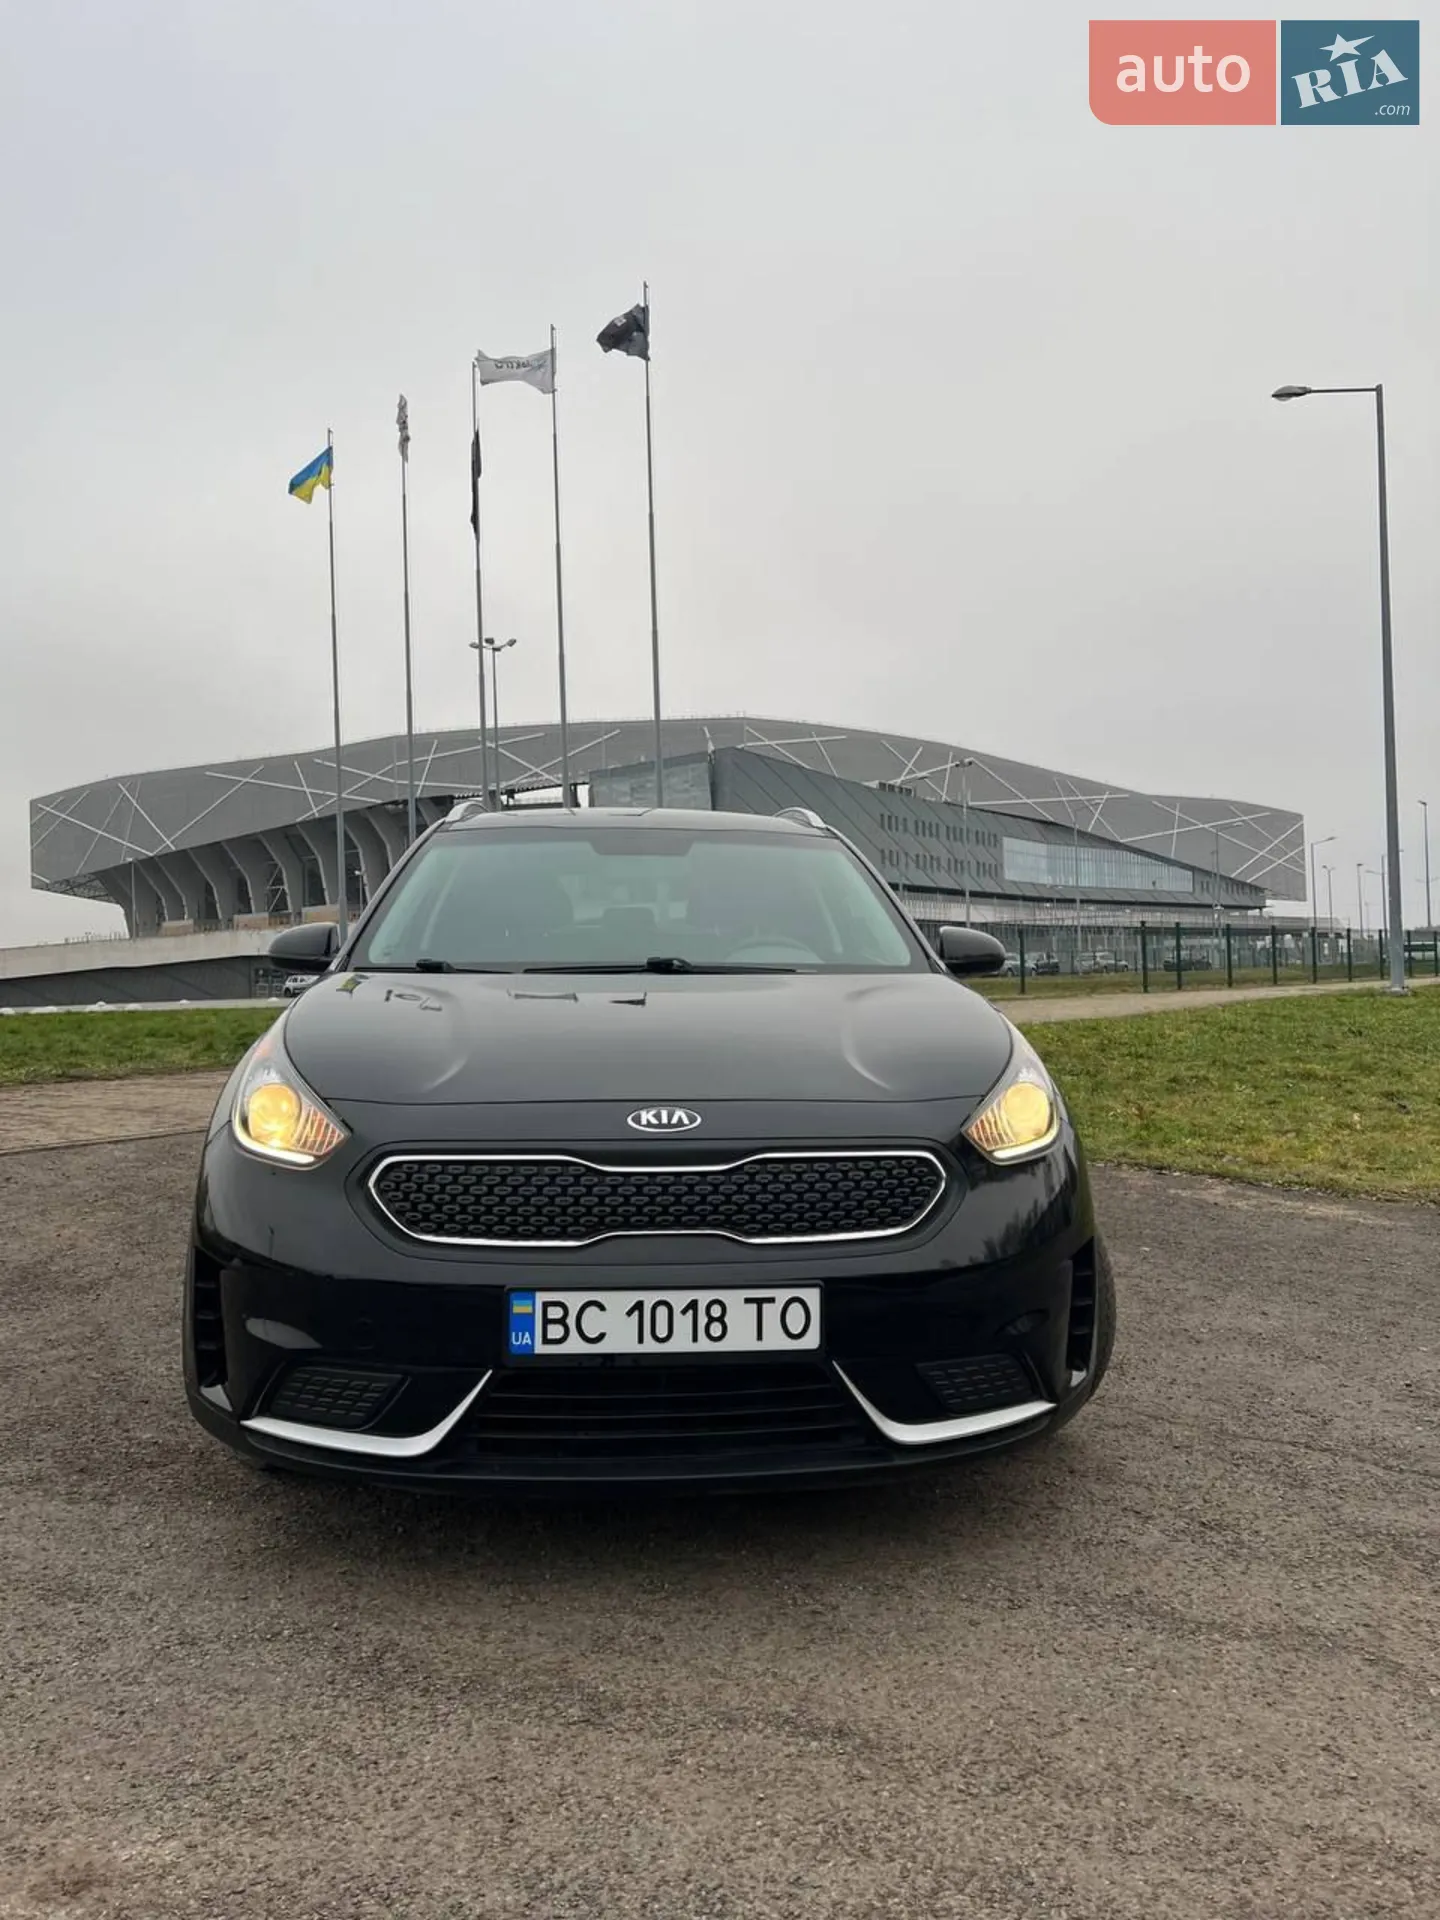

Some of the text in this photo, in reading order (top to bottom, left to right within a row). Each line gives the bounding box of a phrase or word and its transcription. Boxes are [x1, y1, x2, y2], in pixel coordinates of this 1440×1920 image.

[640, 1109, 690, 1125] KIA
[541, 1296, 811, 1345] BC 1018 TO
[511, 1332, 532, 1345] UA
